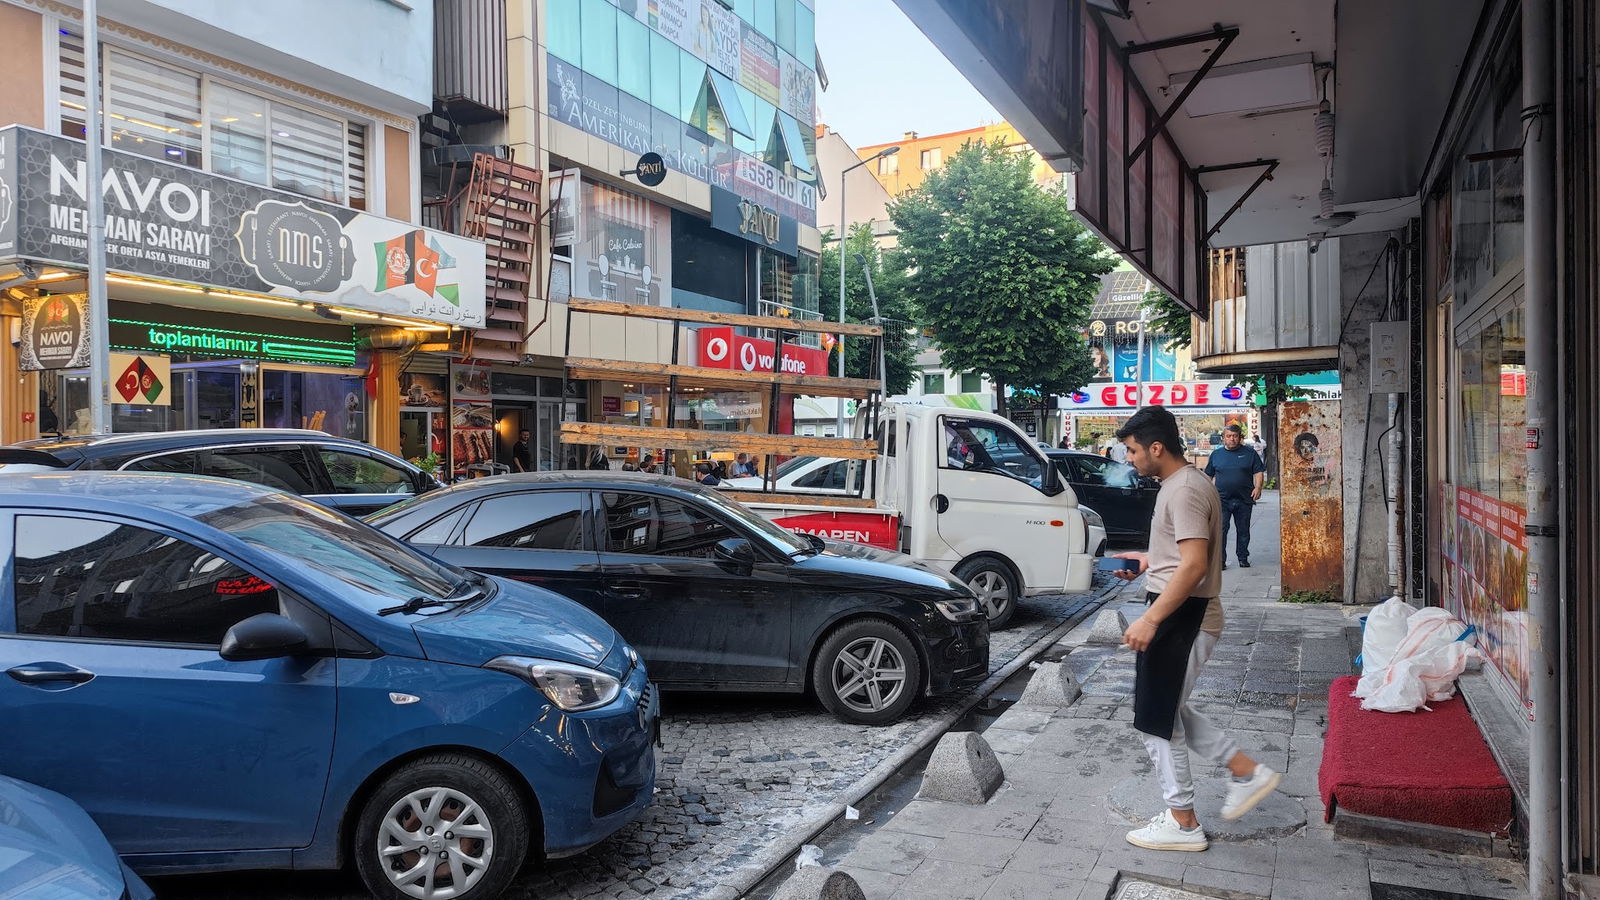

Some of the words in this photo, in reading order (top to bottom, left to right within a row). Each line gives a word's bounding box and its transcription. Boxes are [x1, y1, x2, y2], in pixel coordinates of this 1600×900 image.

[720, 31, 738, 58] YDS
[678, 149, 728, 190] KÜLTÜR
[50, 154, 210, 227] NAVOI
[50, 233, 88, 249] AFGHAN
[120, 246, 143, 259] ORTA
[145, 250, 166, 262] ASYA
[147, 222, 210, 256] SARAYI
[608, 238, 623, 253] Cafe
[40, 331, 73, 346] NAVOI
[148, 328, 258, 353] toplantılarınız
[758, 353, 806, 374] voafone
[1101, 384, 1209, 406] GÖZDE
